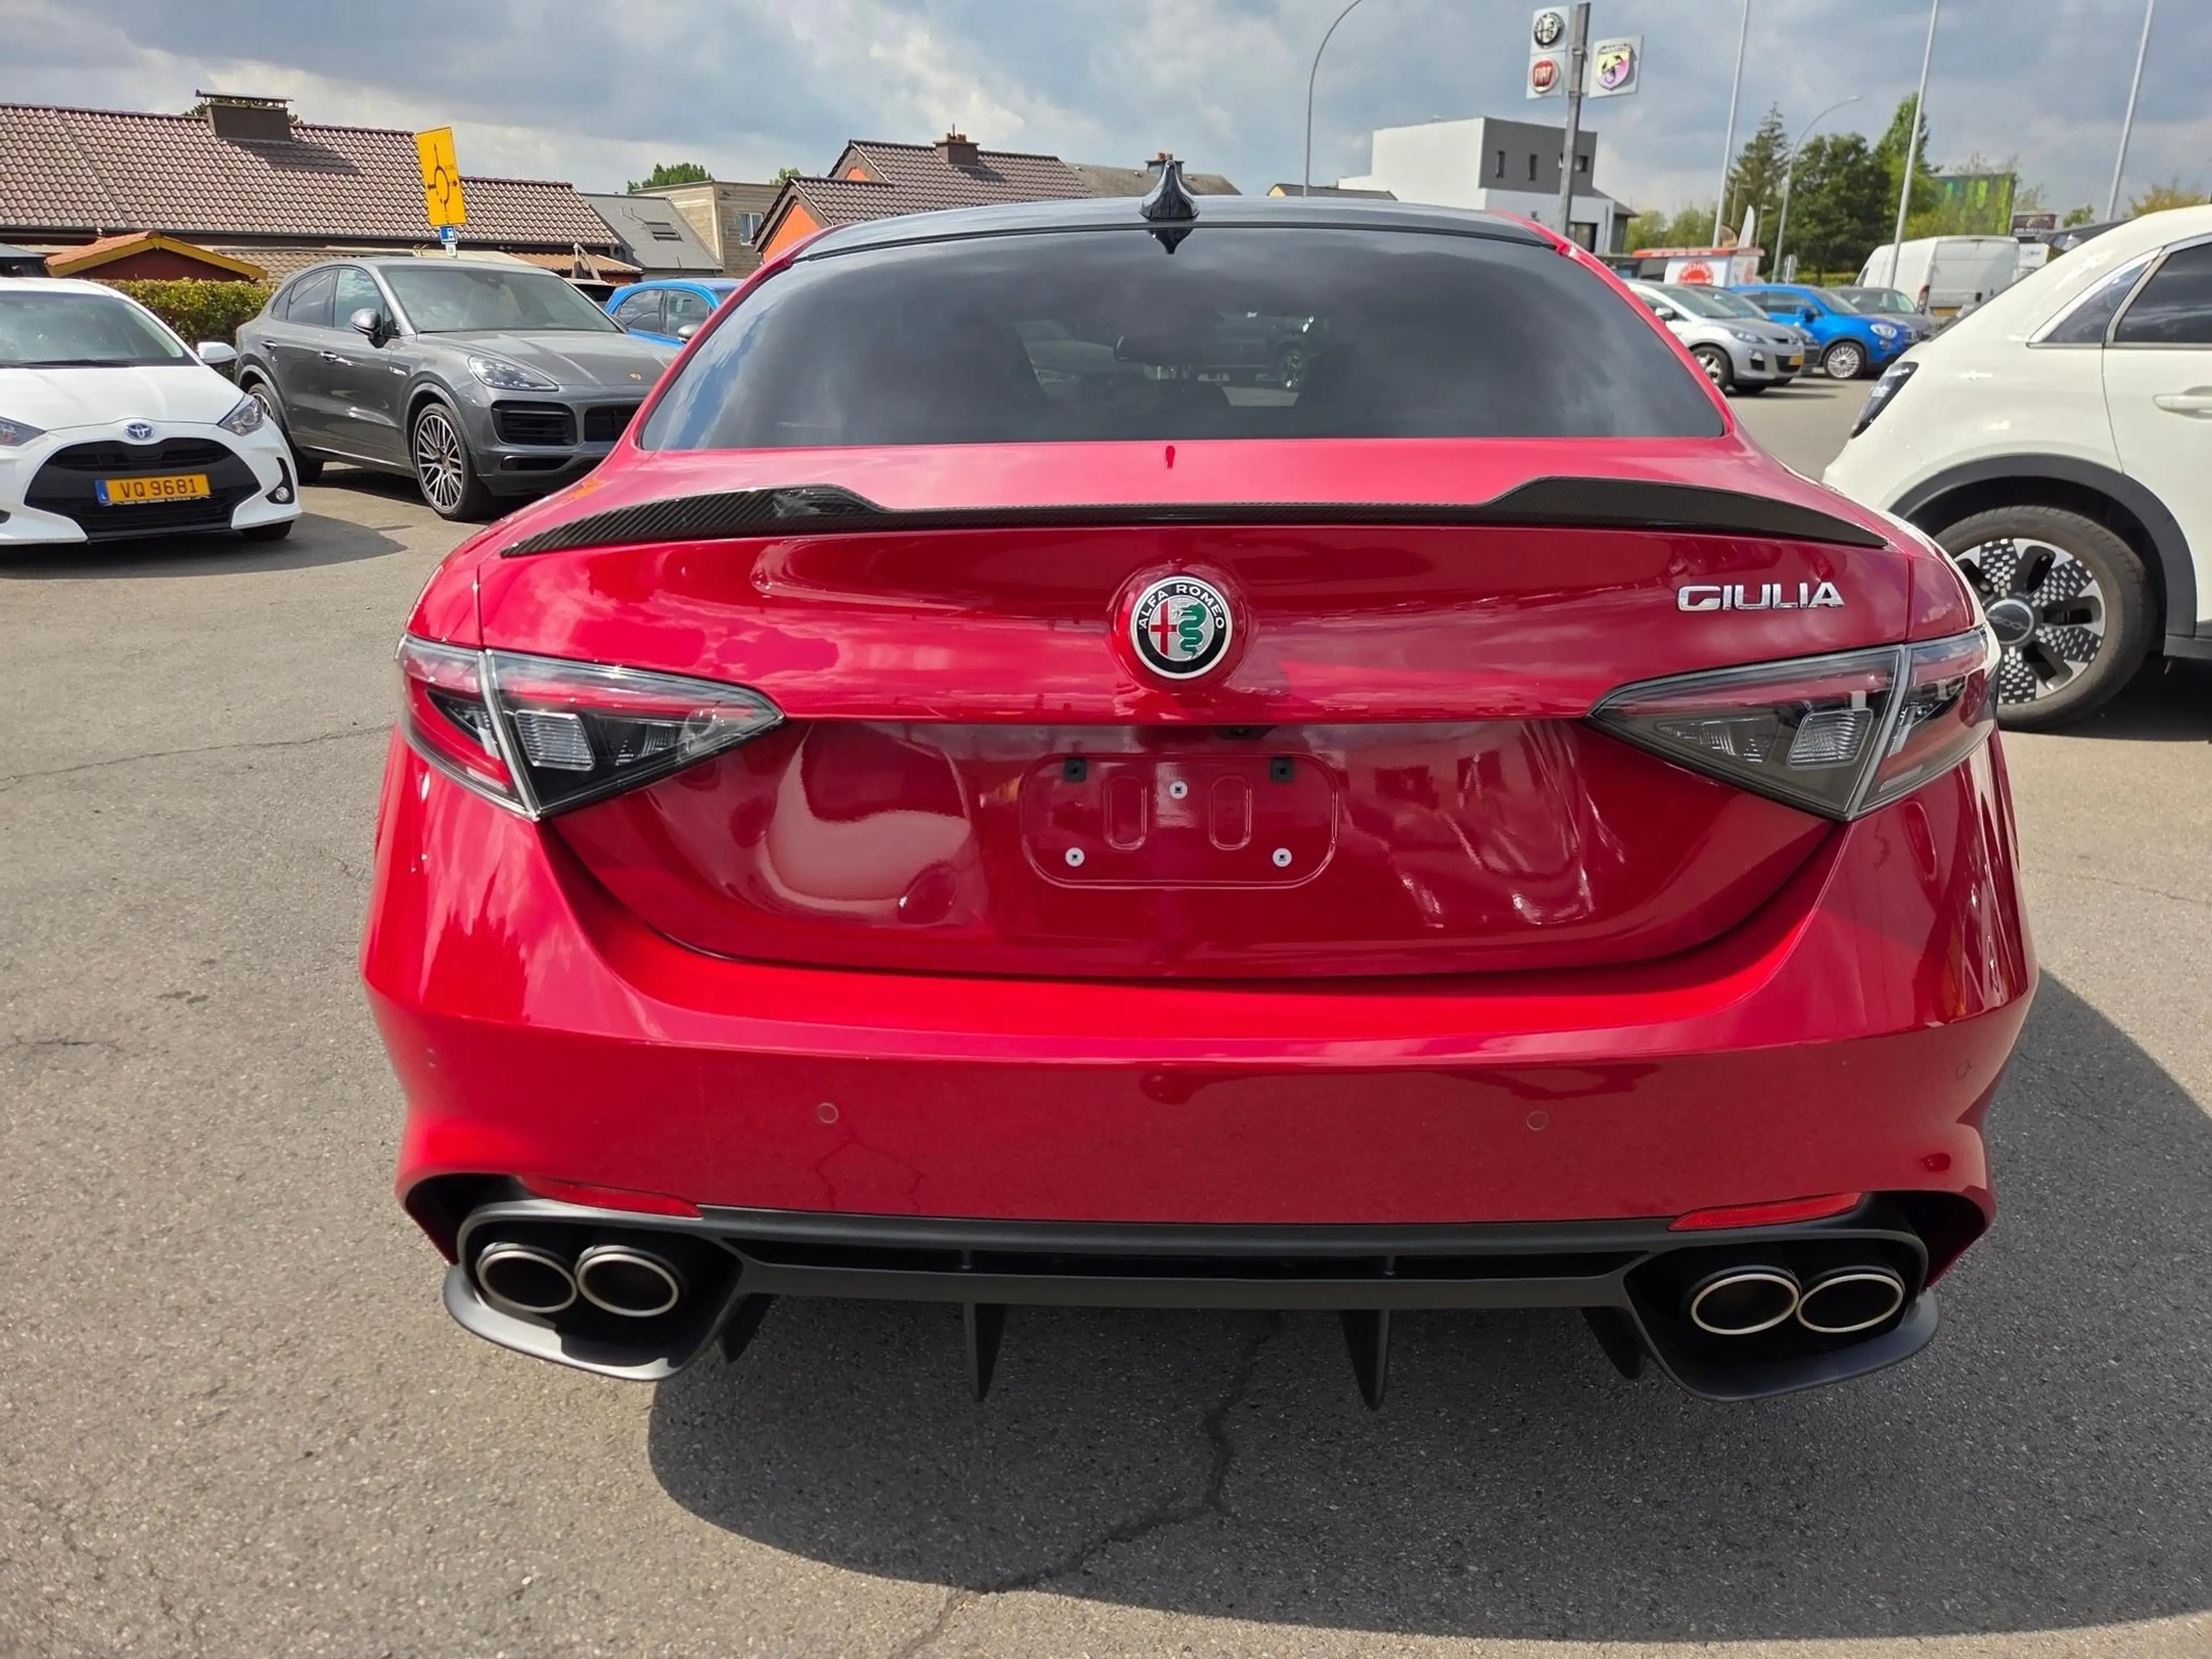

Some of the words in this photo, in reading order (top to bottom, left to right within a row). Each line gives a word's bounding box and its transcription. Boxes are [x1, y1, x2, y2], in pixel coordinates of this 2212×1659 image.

[119, 481, 146, 498] VQ
[150, 478, 198, 496] 9681
[1138, 590, 1168, 629] ALFA
[1176, 584, 1225, 629] ROMEO
[1677, 581, 1845, 612] GIULIA
